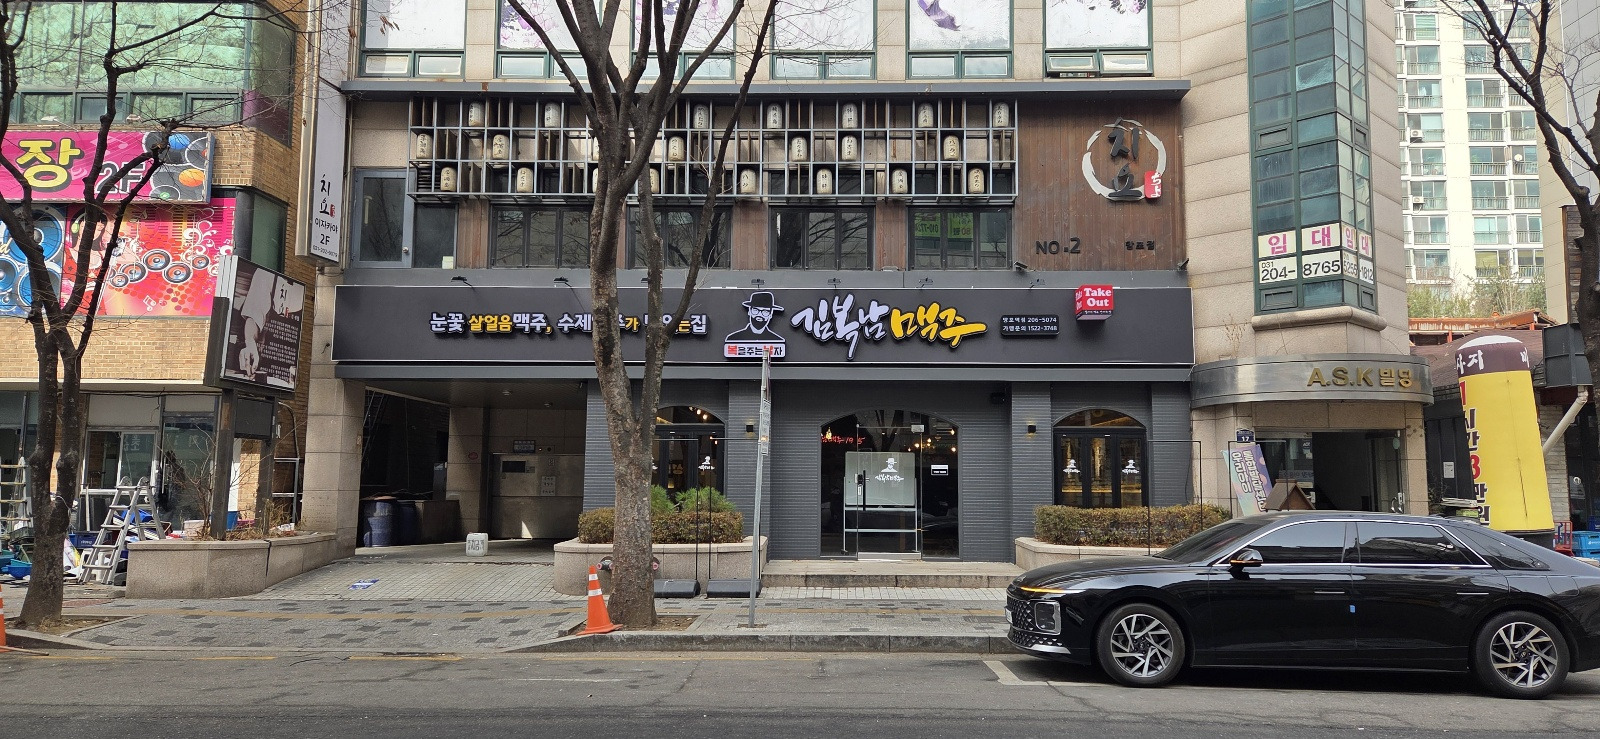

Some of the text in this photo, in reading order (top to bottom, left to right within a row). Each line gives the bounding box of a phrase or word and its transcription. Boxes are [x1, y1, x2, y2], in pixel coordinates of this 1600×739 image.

[16, 138, 82, 188] 장
[94, 161, 146, 193] 2F
[314, 217, 338, 234] 이자카야
[320, 233, 331, 246] 2F
[1083, 287, 1112, 297] Take
[1086, 297, 1110, 307] Out
[430, 312, 708, 334] 눈꽃 살얼음맥주, 수제가 는집
[790, 293, 988, 360] 김복남 맥주
[1306, 366, 1413, 388] A.S.K 빌딩
[1231, 451, 1252, 494] 우리아이
